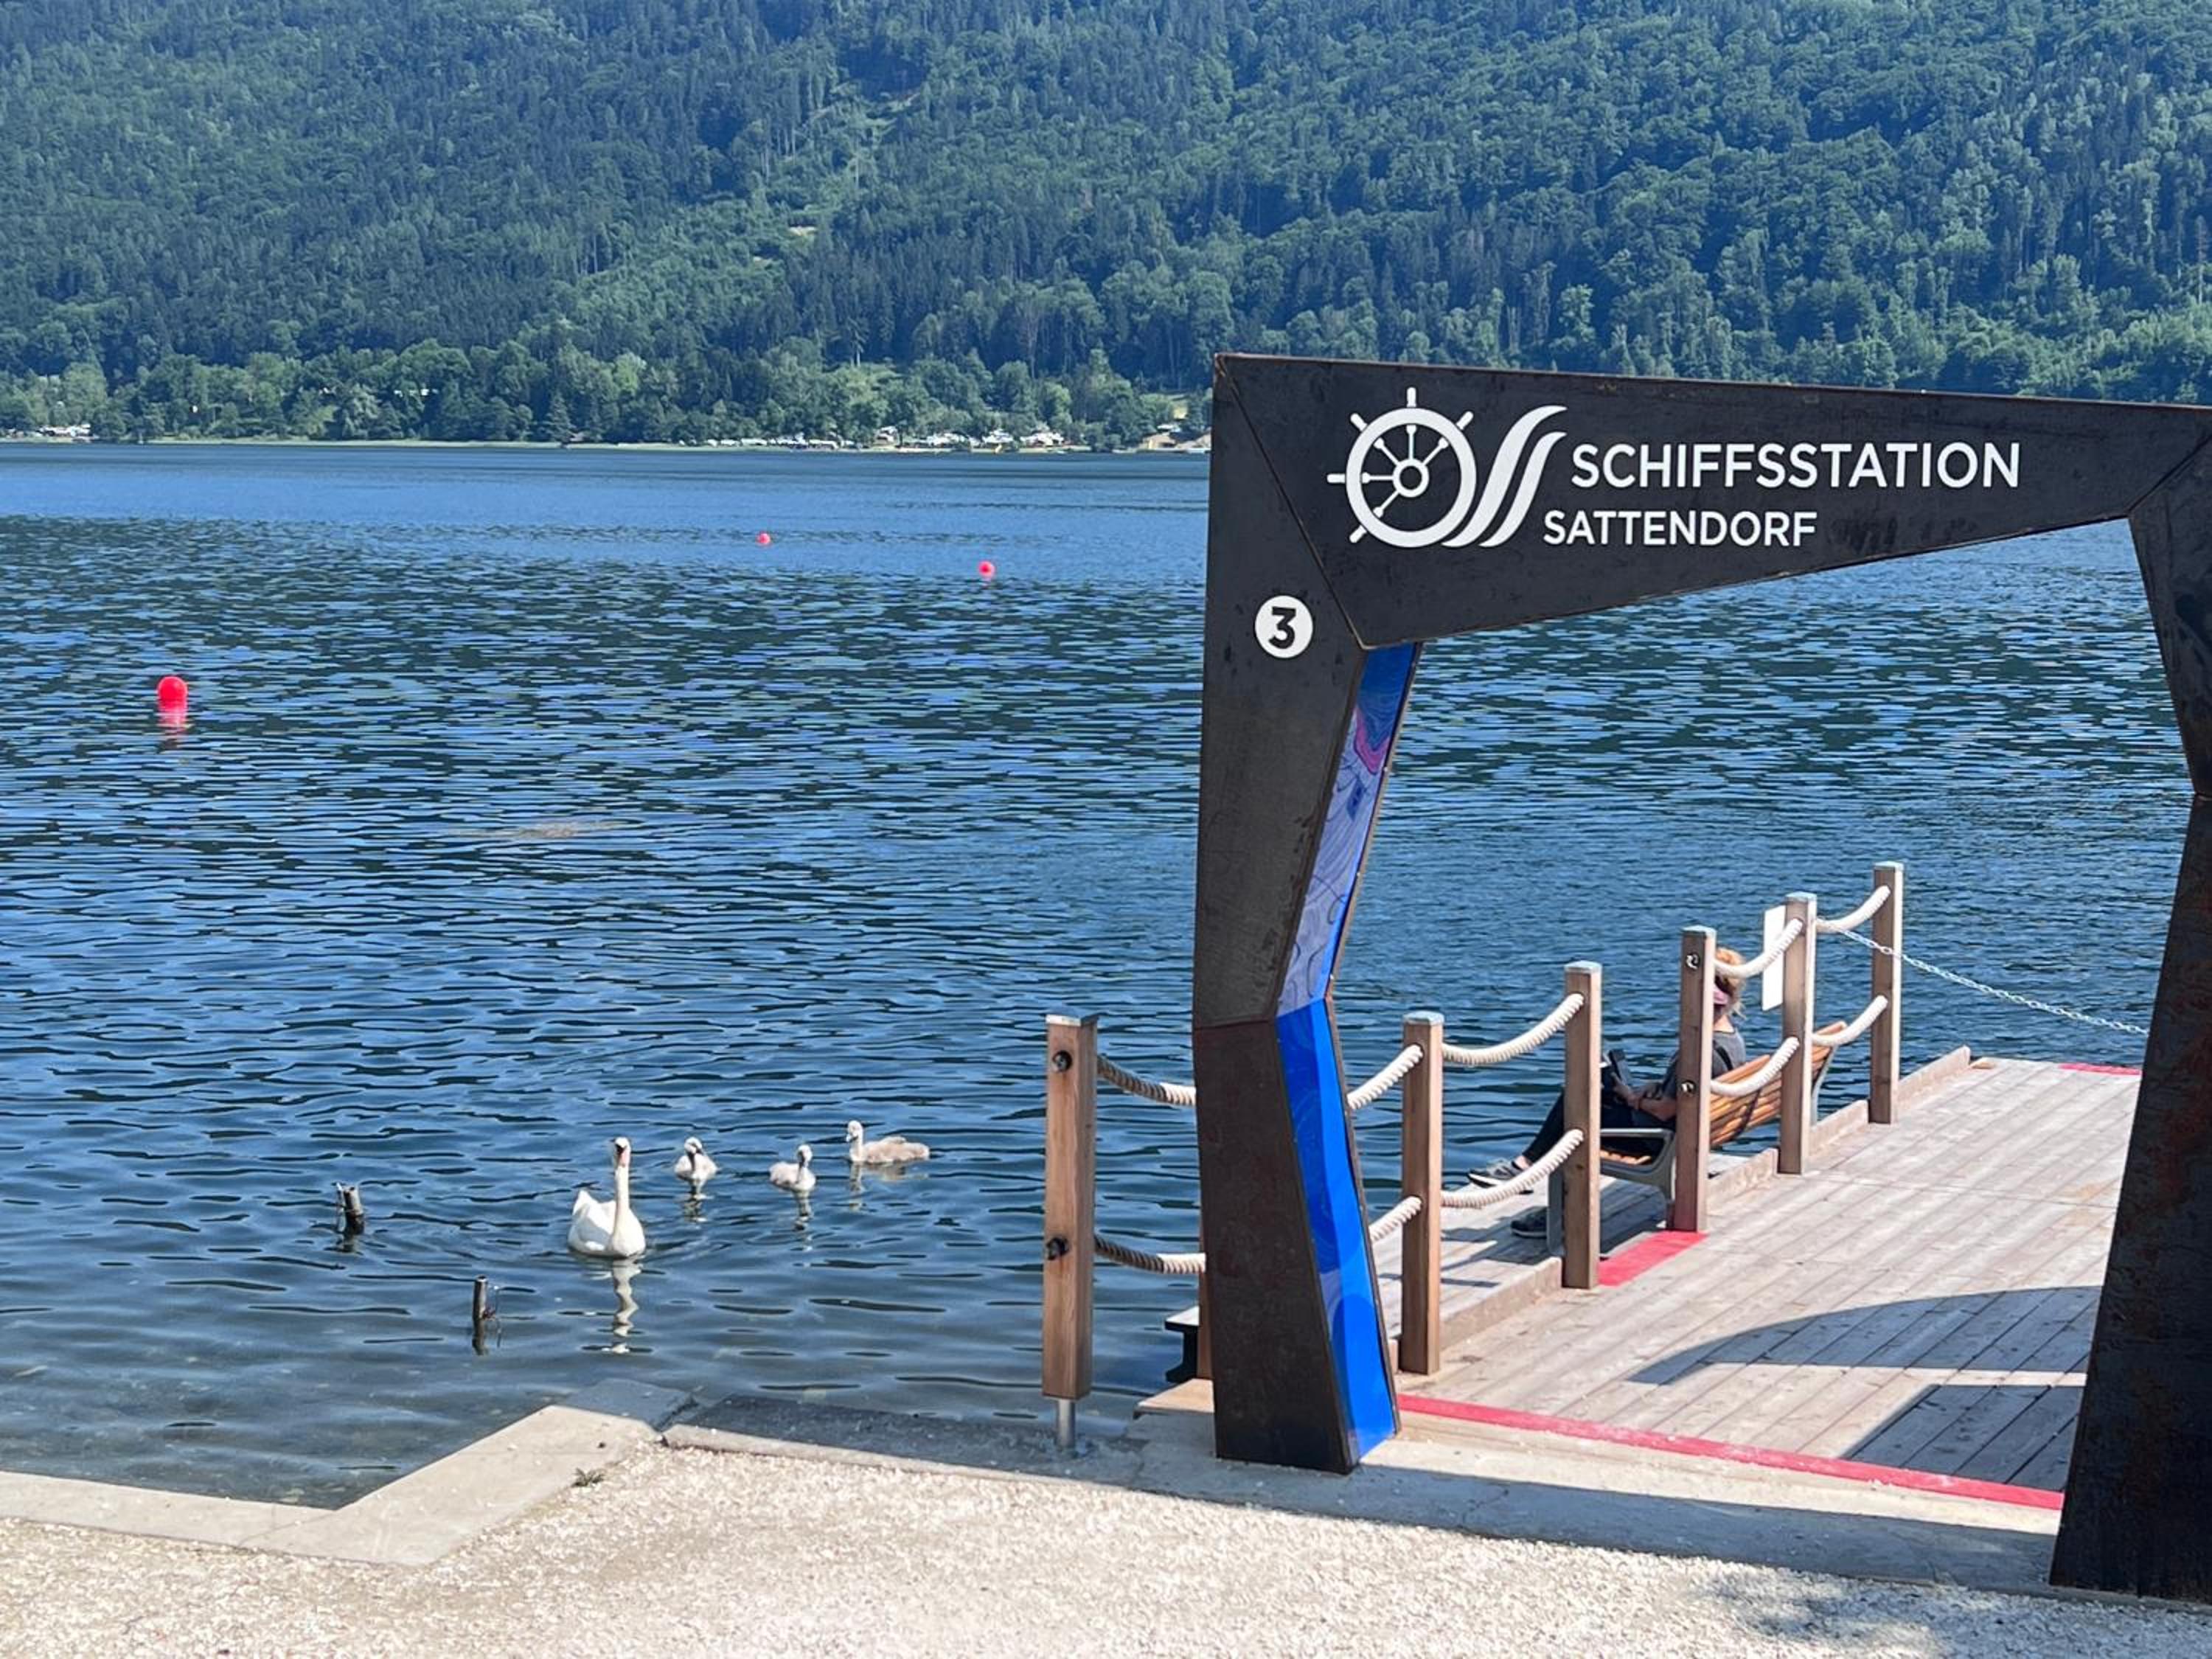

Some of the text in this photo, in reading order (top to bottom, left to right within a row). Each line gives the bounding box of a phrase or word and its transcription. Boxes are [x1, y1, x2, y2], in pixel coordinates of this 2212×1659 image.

[1571, 442, 2020, 488] SCHIFFSSTATION
[1543, 509, 1818, 546] SATTENDORF
[1268, 606, 1296, 650] 3
